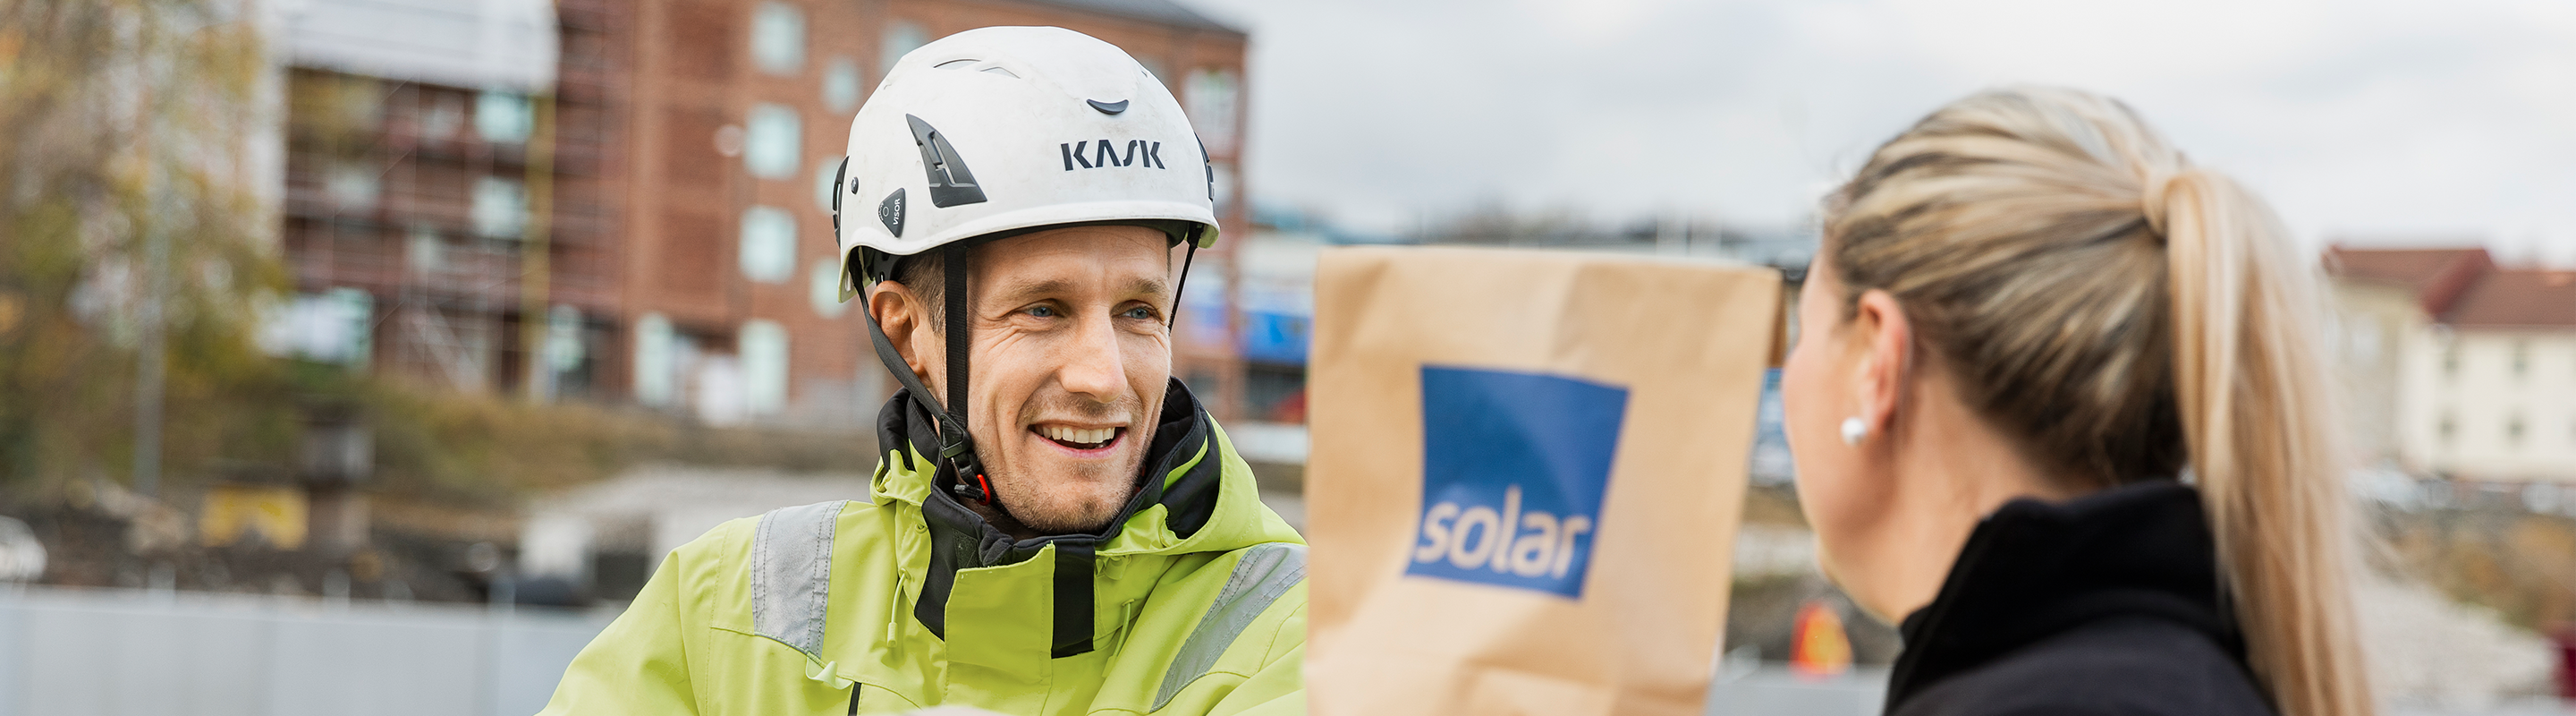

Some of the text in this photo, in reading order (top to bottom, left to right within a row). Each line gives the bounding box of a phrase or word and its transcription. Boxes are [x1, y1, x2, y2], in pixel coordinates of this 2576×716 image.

[1060, 139, 1165, 171] KASK
[893, 198, 901, 225] VISOR
[1415, 485, 1591, 579] solar
